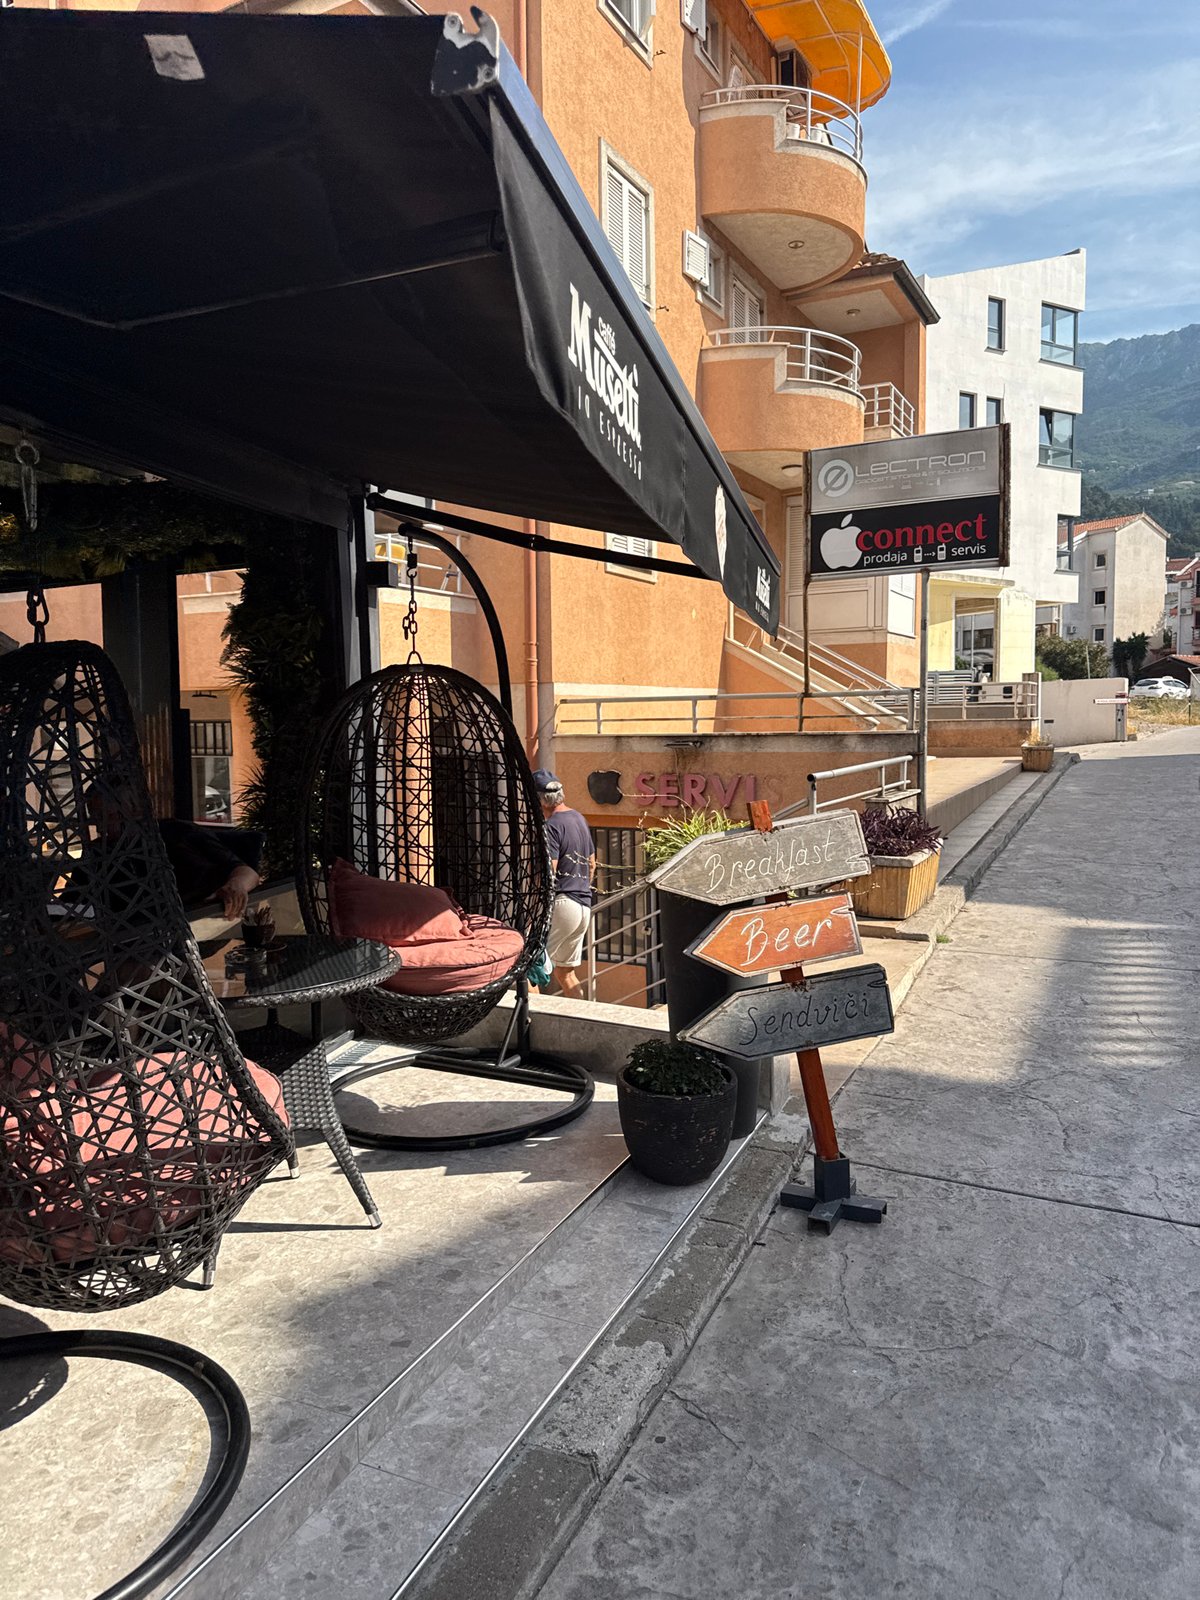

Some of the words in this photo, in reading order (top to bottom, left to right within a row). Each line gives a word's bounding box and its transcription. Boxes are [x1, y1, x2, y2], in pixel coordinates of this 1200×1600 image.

[567, 281, 642, 452] Musetti
[599, 411, 642, 481] ESPRESSO
[856, 513, 988, 552] connect
[863, 551, 908, 567] prodaja
[951, 543, 987, 556] servis
[704, 829, 836, 894] Breakfast
[739, 916, 833, 967] Beer
[739, 992, 871, 1046] Sendviči
